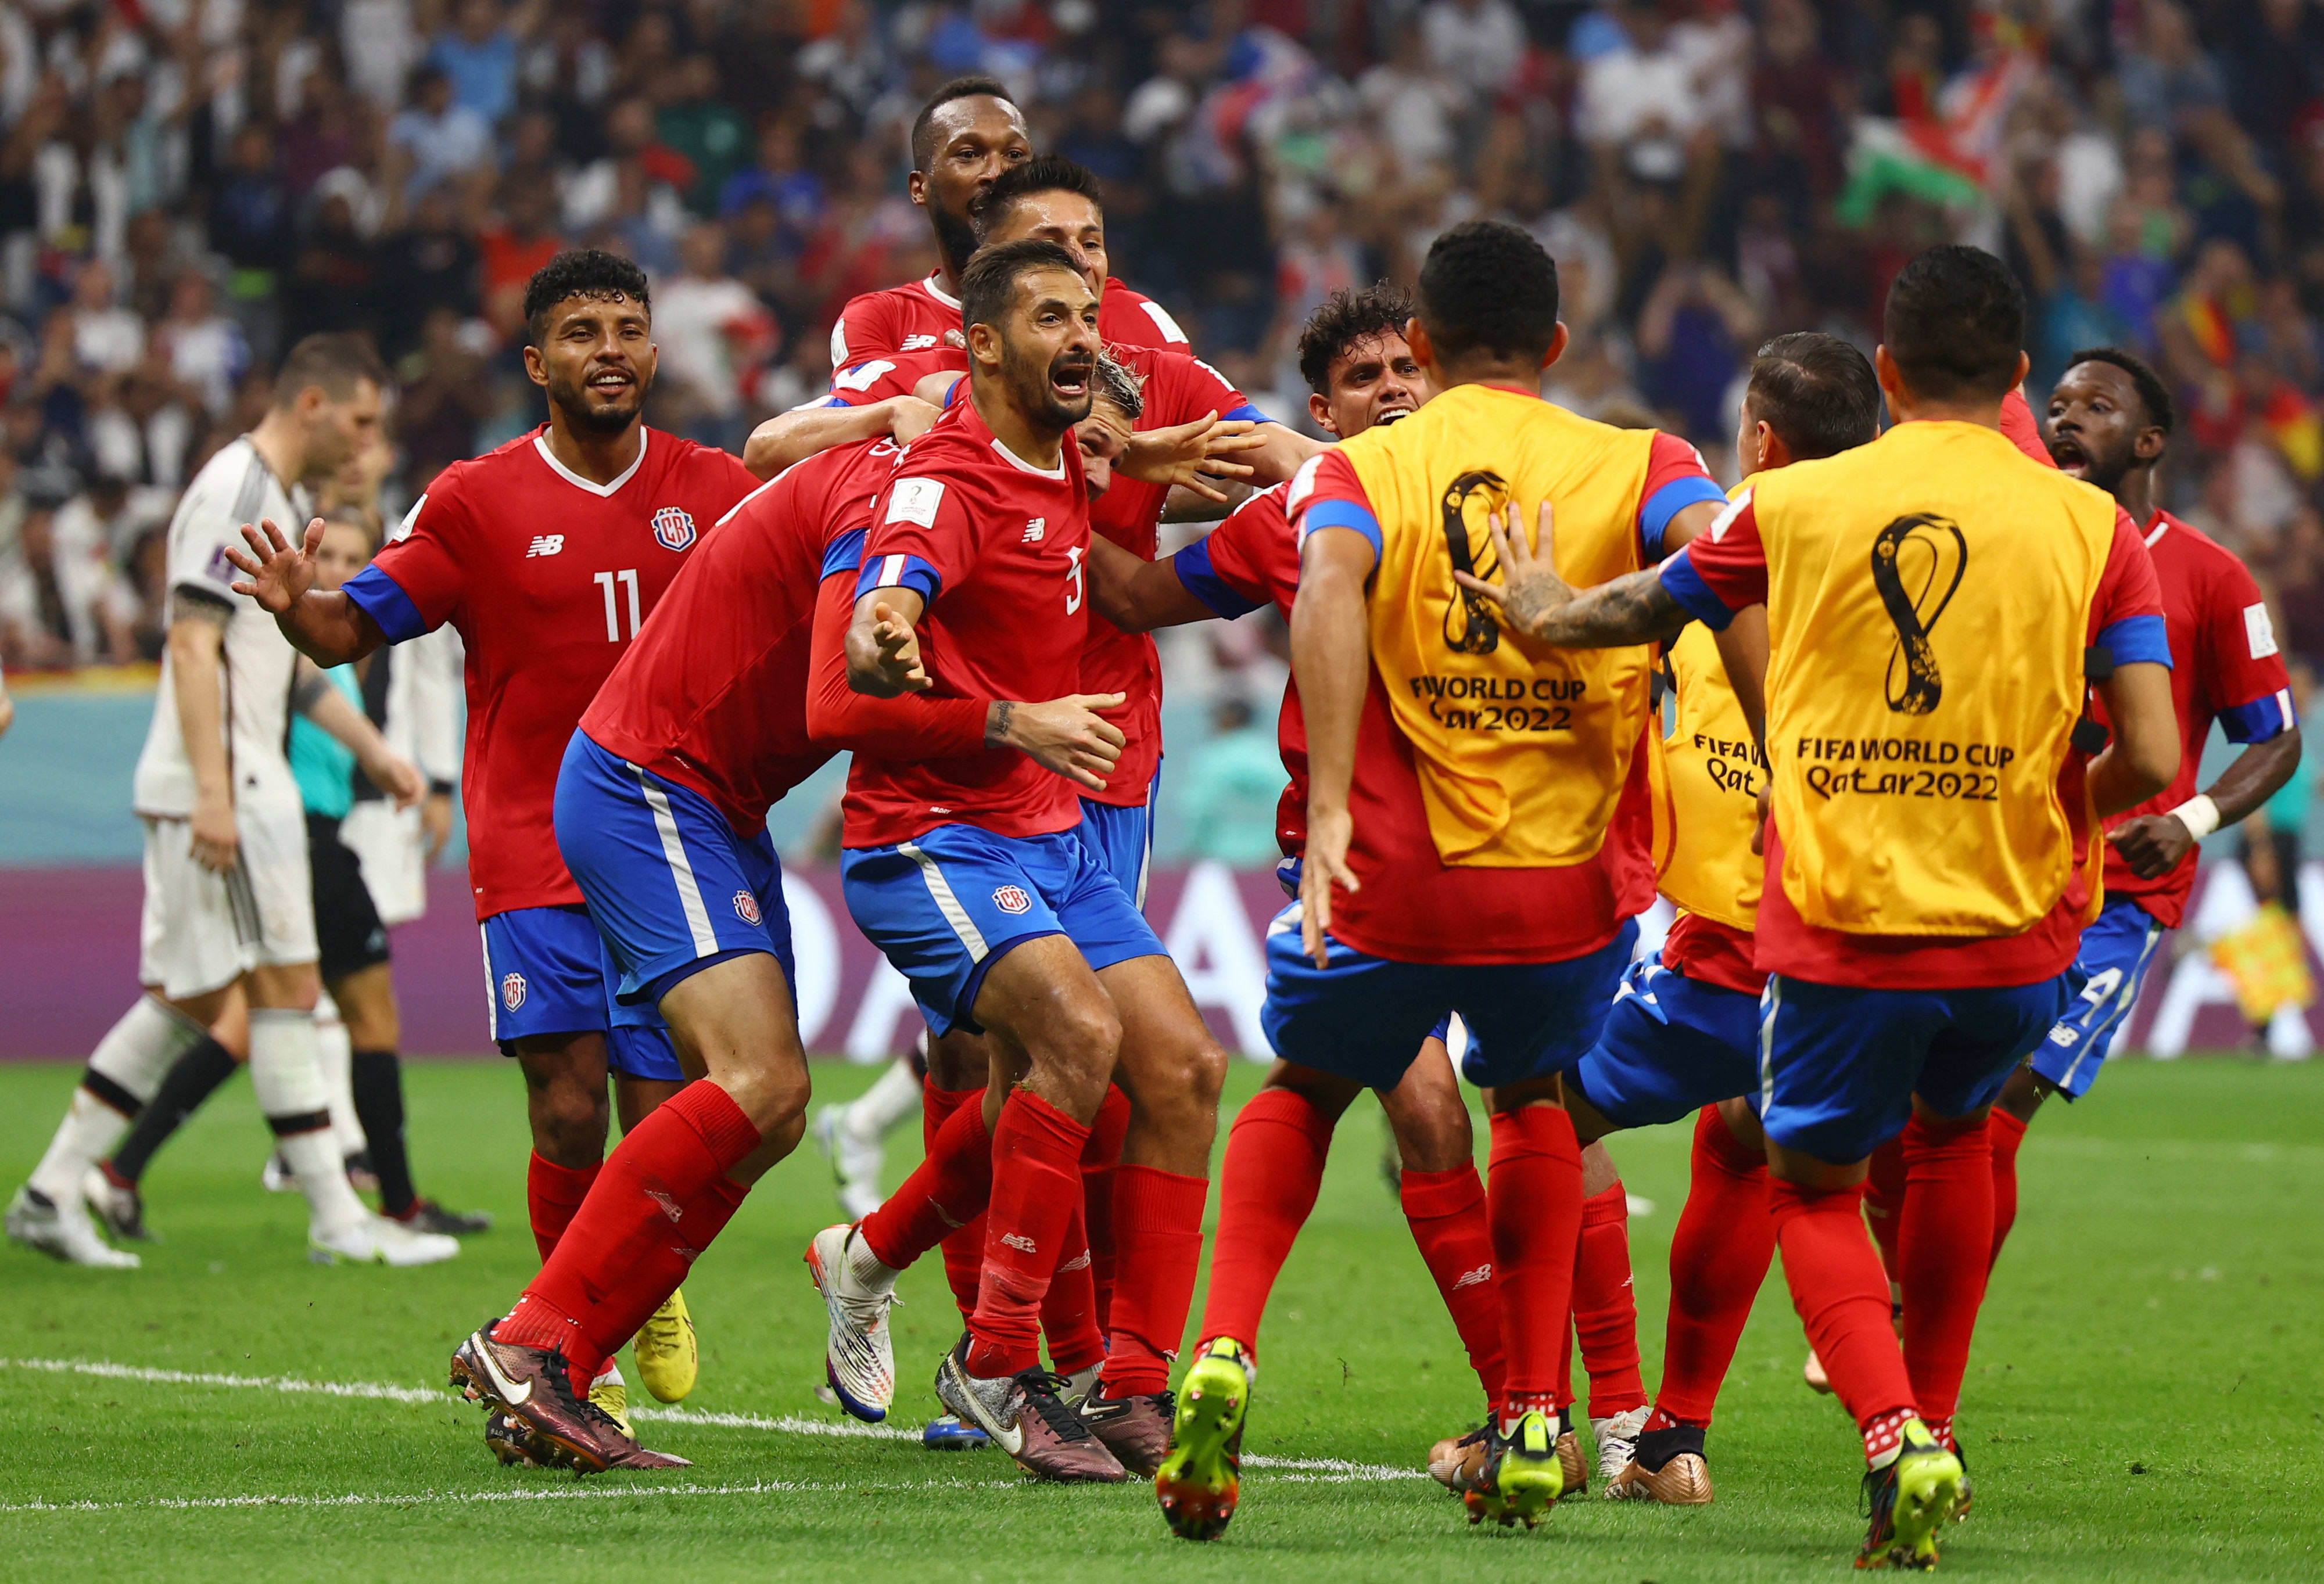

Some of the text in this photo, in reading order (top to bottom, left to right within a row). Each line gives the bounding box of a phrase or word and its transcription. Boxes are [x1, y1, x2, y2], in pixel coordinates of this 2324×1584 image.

[525, 534, 565, 558] NB
[593, 568, 641, 642] 11
[1532, 678, 1586, 702] CUP
[1694, 733, 1747, 762] FIFA
[1798, 738, 2014, 769] FIFA WORLD CUP
[2079, 966, 2124, 1028] 4
